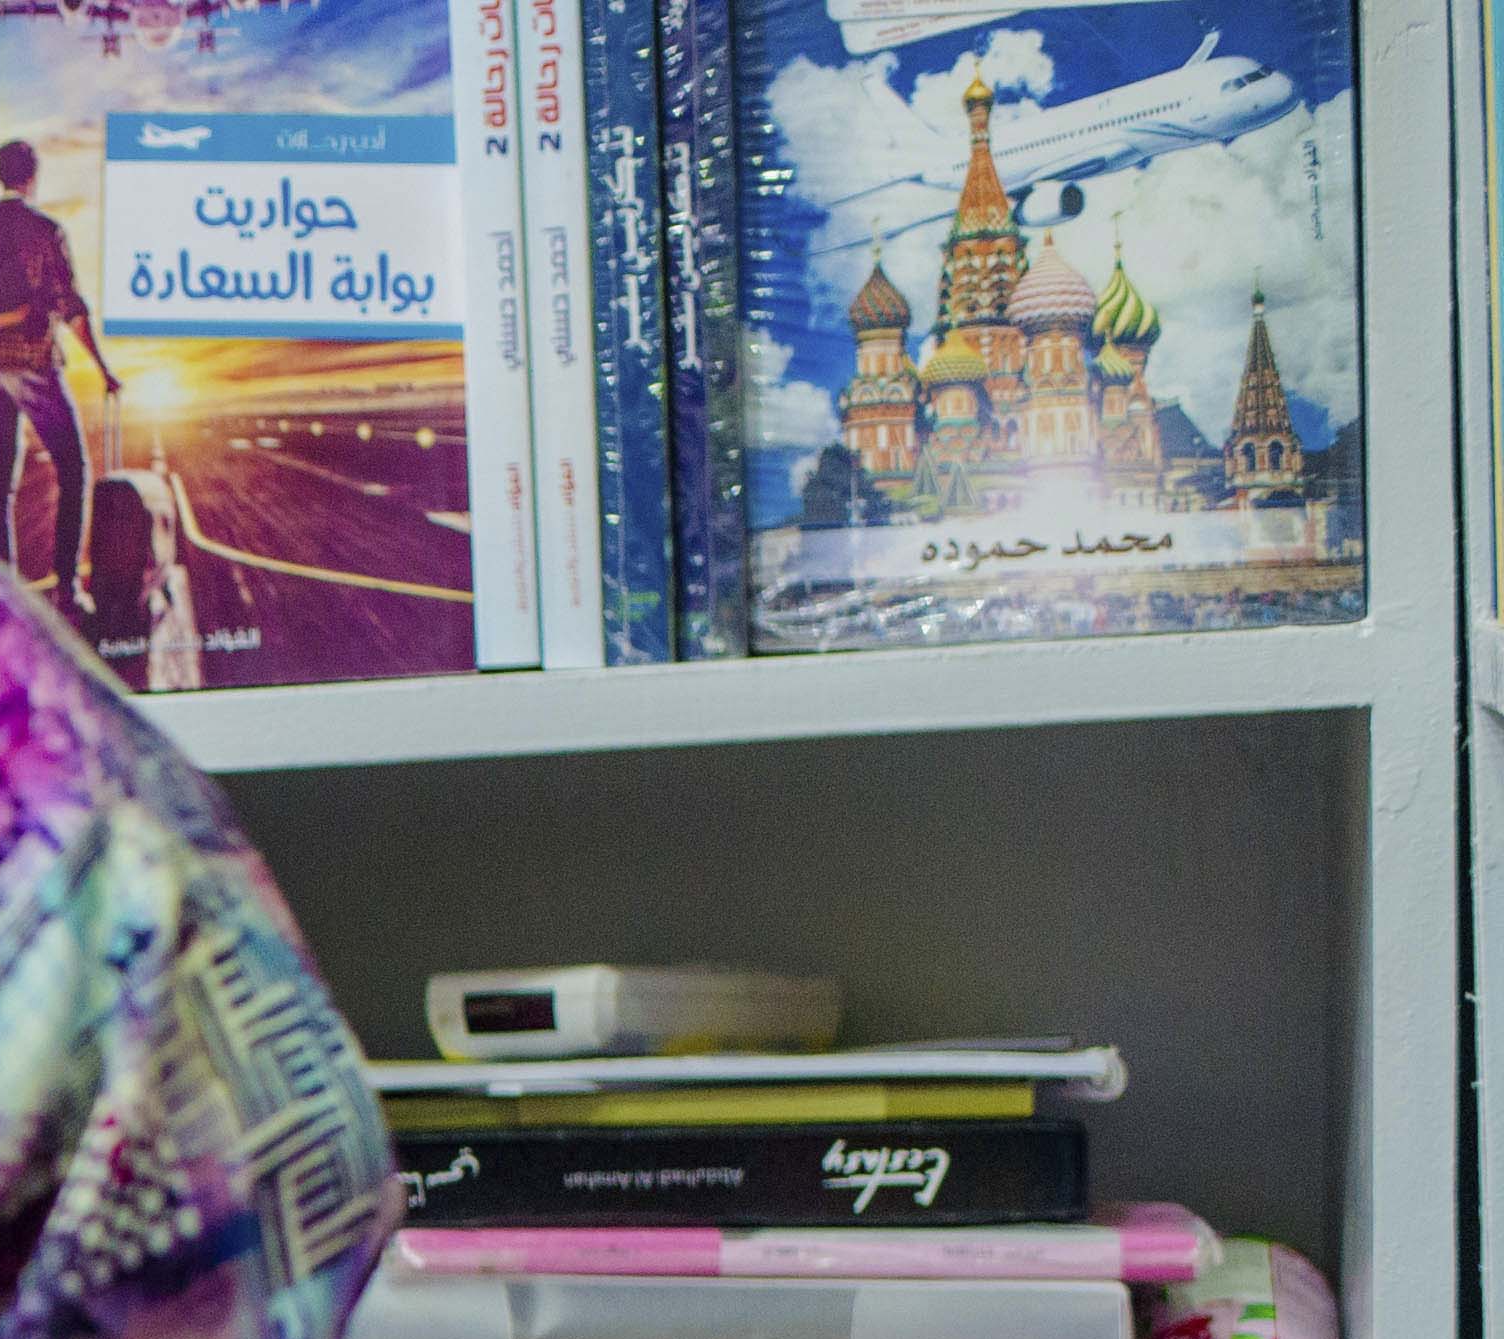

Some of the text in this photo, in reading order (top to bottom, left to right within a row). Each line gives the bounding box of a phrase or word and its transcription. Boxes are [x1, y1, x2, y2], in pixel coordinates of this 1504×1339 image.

[487, 134, 510, 156] 2
[539, 131, 563, 152] 2
[130, 249, 435, 315] بوابة السعادة
[1054, 529, 1175, 560] محمد
